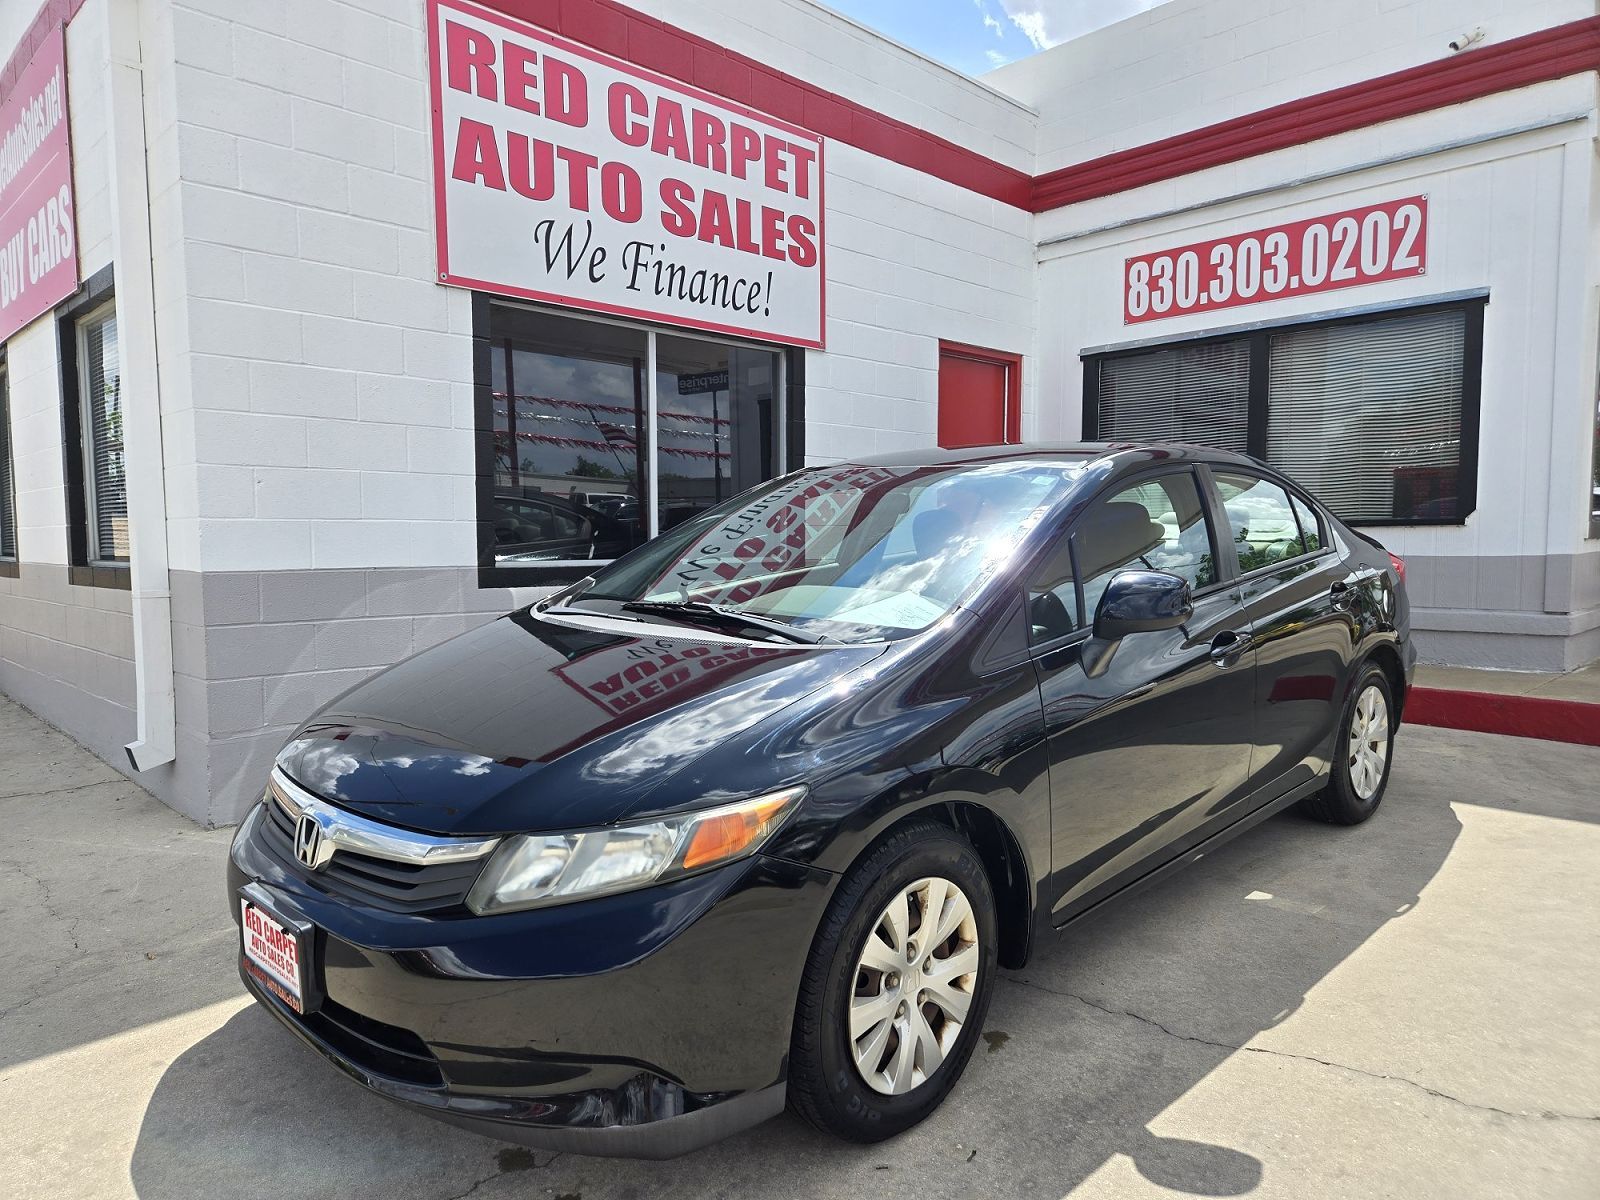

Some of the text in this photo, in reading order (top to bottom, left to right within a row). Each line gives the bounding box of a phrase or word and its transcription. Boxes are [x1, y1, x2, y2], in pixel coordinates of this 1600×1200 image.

[446, 20, 816, 199] RED CARPET
[0, 184, 72, 309] BUY CARS
[452, 117, 817, 268] AUTO SALES
[534, 219, 773, 317] We Finance!
[1128, 204, 1422, 317] 830.303.0202
[245, 907, 262, 937] RED
[264, 920, 298, 965] CARPET
[251, 934, 266, 956] AUTO
[268, 944, 285, 972] SALES
